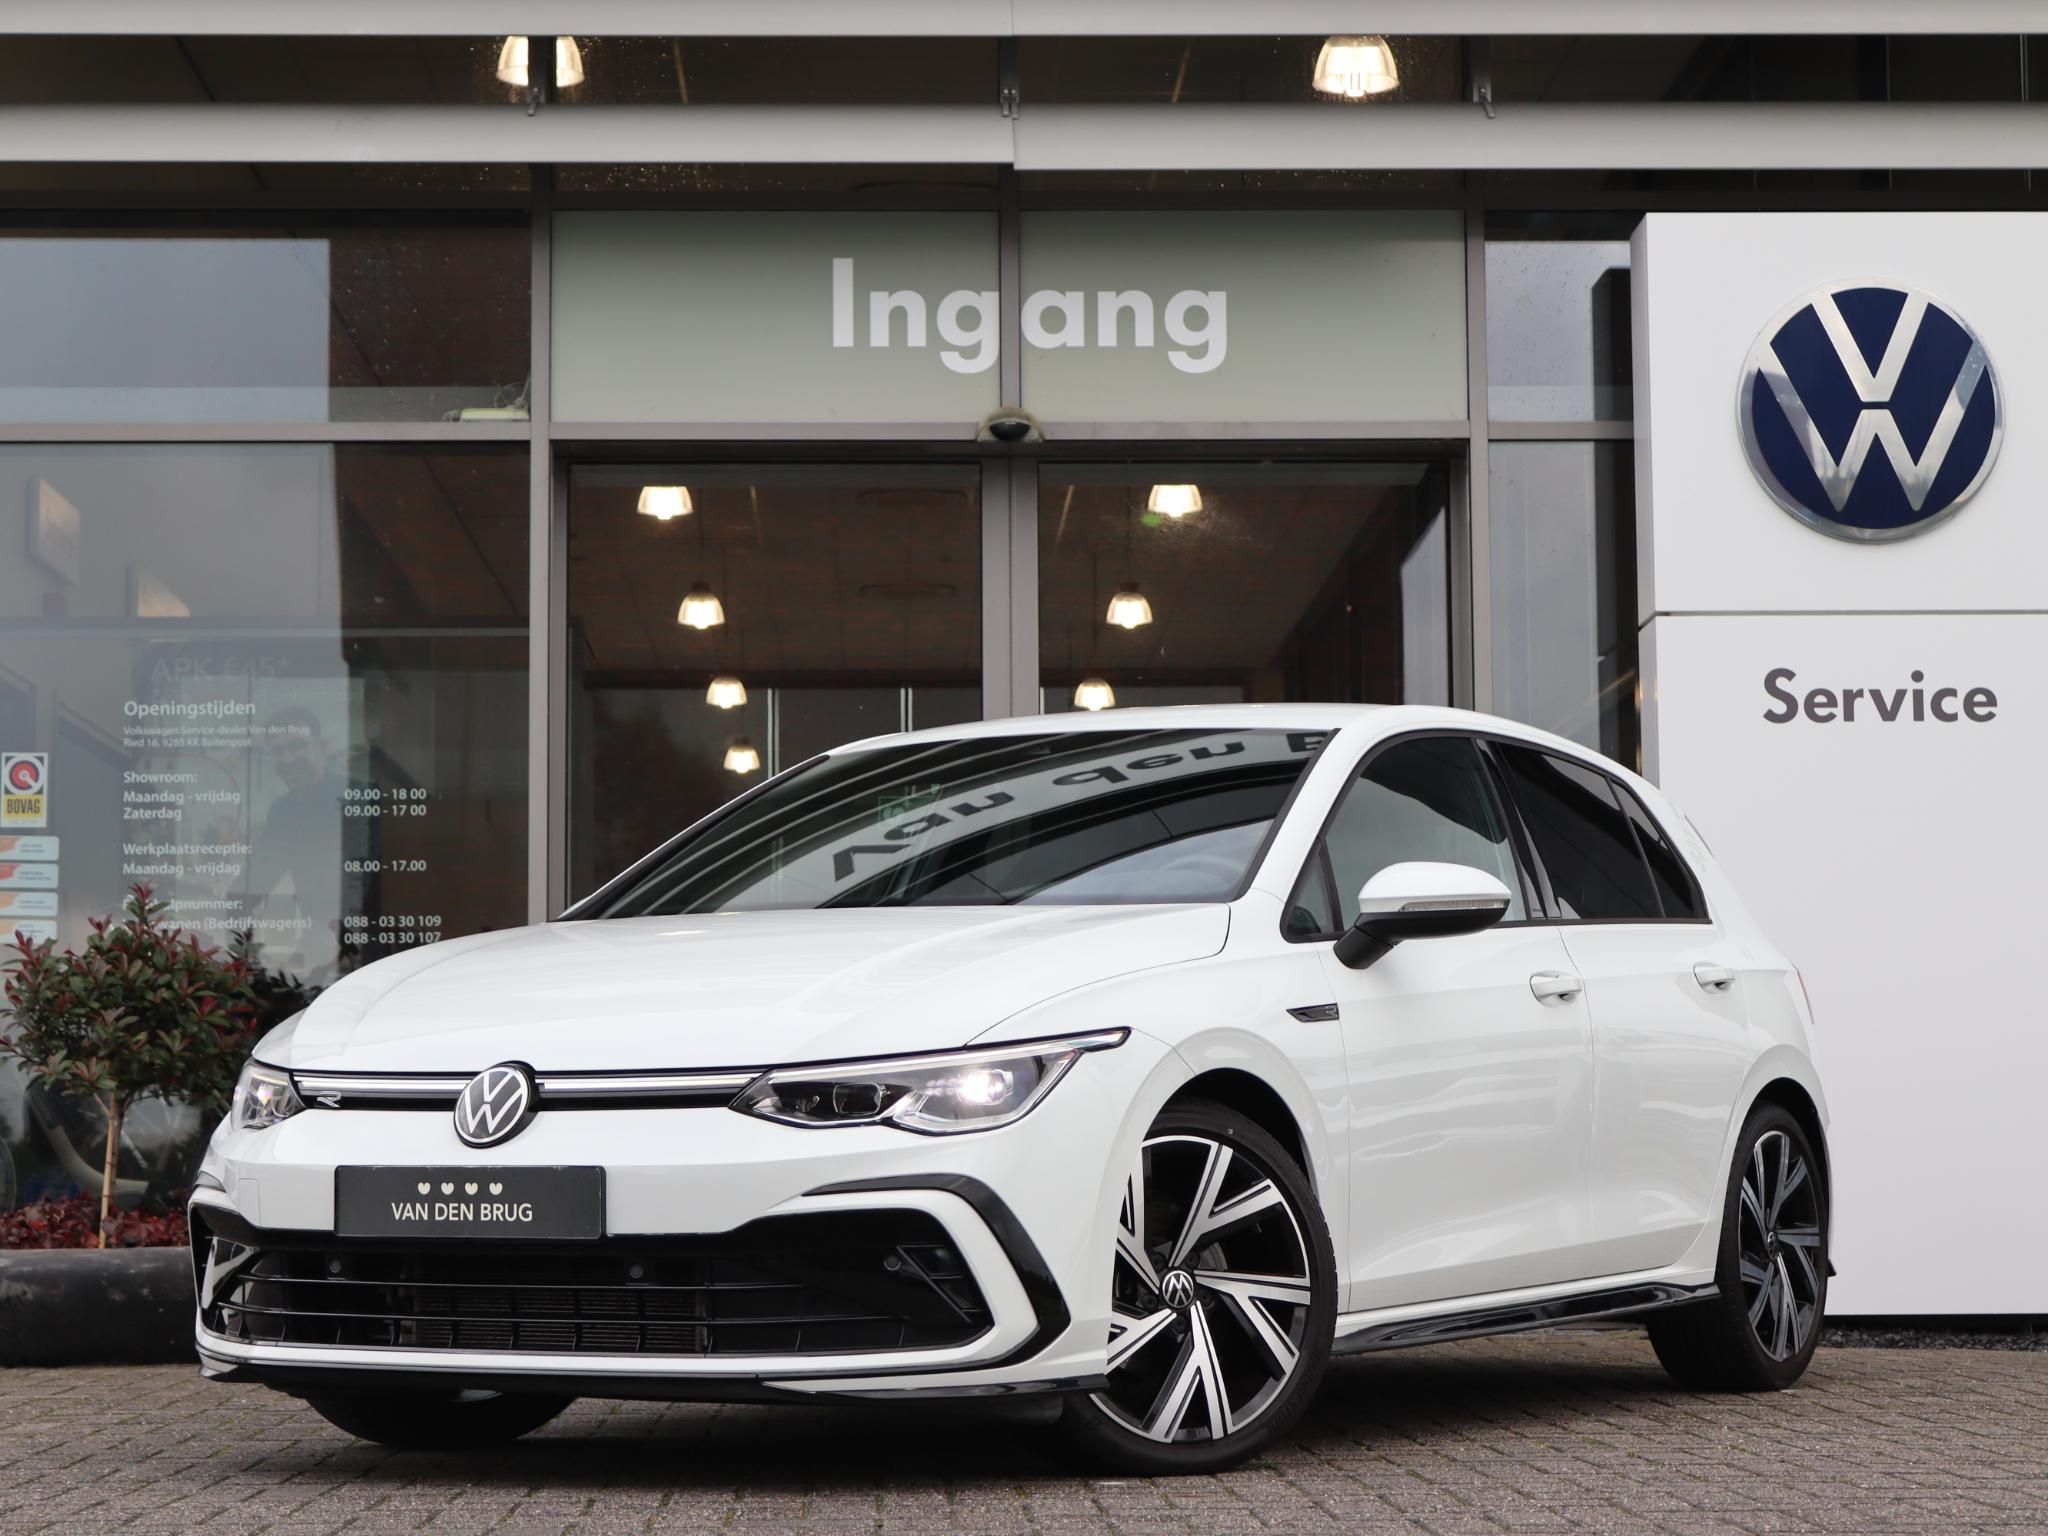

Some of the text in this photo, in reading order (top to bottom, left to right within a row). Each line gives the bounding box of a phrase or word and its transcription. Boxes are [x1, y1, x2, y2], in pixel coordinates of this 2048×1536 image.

[832, 257, 1227, 374] Ingang
[1763, 668, 1998, 723] Service
[124, 700, 256, 719] Openingstijden
[249, 724, 266, 735] Van
[268, 724, 287, 734] den
[123, 771, 198, 783] Showroom:
[123, 791, 184, 803] Maandag
[195, 790, 241, 804] vrijdag
[344, 789, 380, 800] 09.00
[7, 798, 41, 814] BOVAG
[344, 805, 380, 816] 09.00
[123, 808, 182, 821] Zaterdag
[123, 842, 252, 856] Werkplaatsreceptie:
[123, 863, 184, 876] Maandag
[195, 862, 241, 876] vrijdag
[344, 861, 380, 872] 08.00
[392, 860, 427, 872] 17.00
[204, 916, 312, 931] (Bedrijfswagens)
[344, 916, 368, 928] 088
[379, 916, 395, 927] 03
[398, 916, 414, 927] 30
[418, 916, 442, 927] 109
[344, 932, 368, 944] 088
[379, 932, 395, 943] 03
[398, 932, 414, 943] 30
[418, 932, 441, 943] 107
[391, 1203, 533, 1221] VAN DEN BRUG
